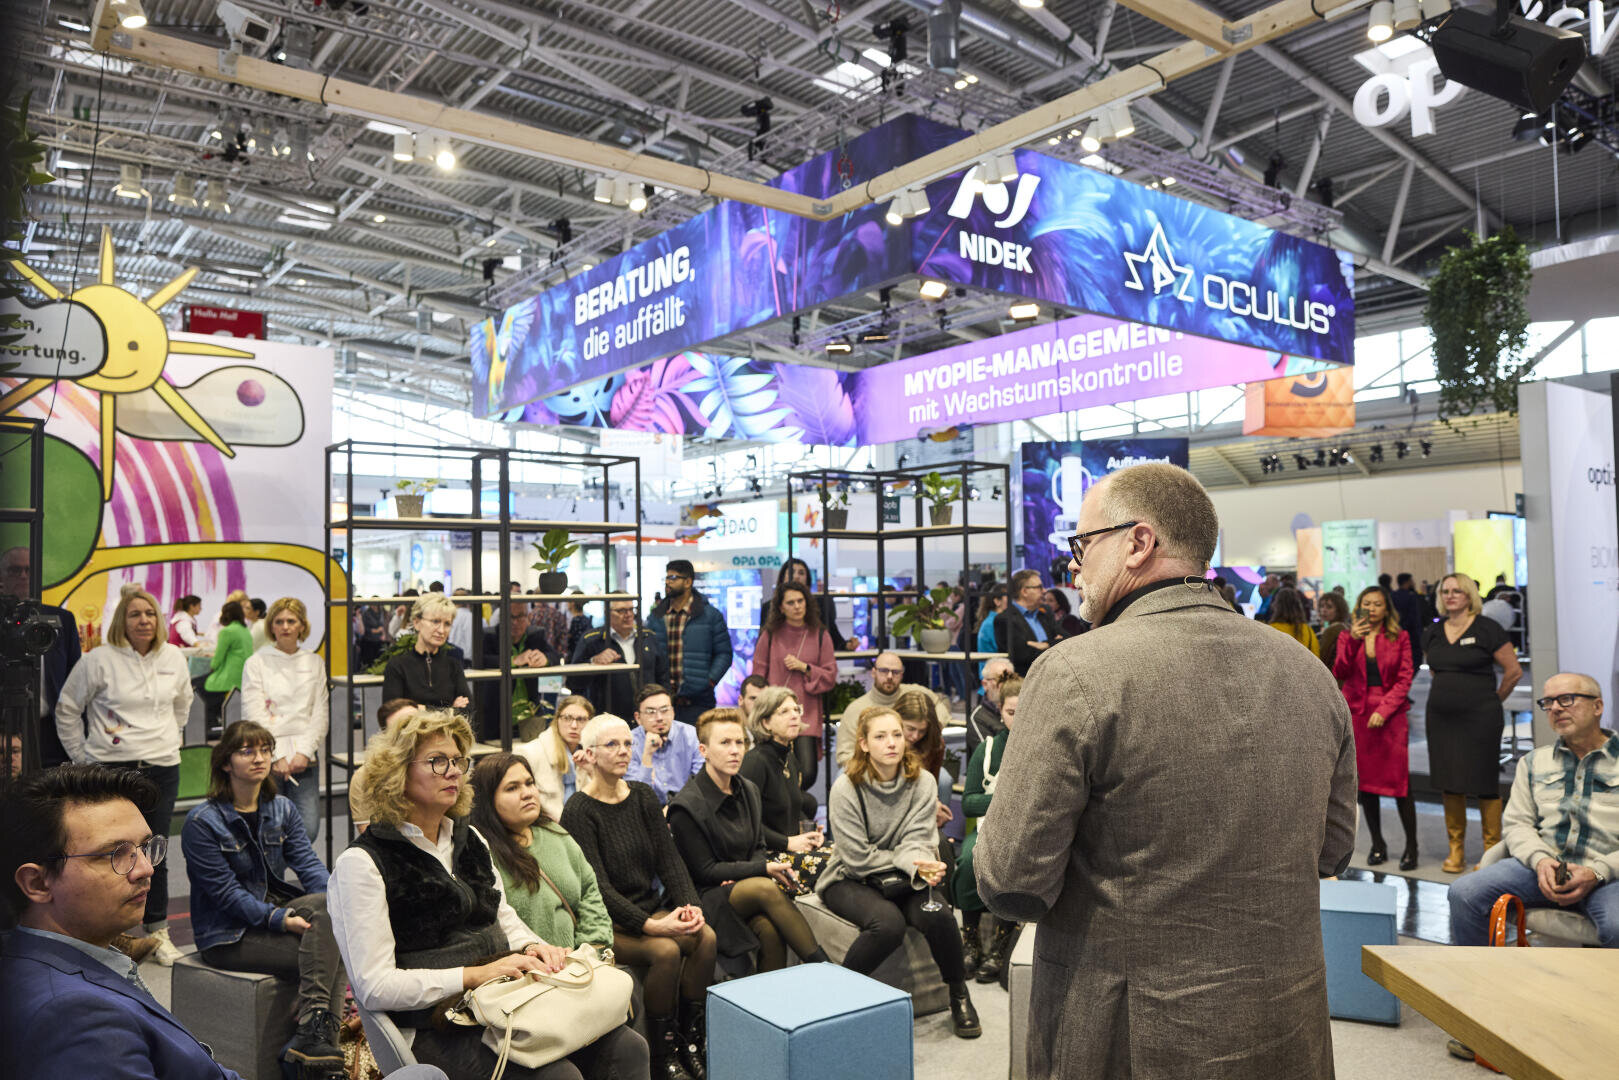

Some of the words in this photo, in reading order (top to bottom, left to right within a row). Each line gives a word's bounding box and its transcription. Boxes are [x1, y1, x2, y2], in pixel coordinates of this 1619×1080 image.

[575, 245, 696, 326] BERATUNG,
[959, 230, 1034, 274] NIDEK
[583, 326, 610, 361] die
[614, 295, 686, 349] auffällt
[904, 323, 1184, 397] MYOPIE-MANAGEMEN
[909, 400, 940, 424] mit
[944, 350, 1184, 417] Wachstumskontrolle
